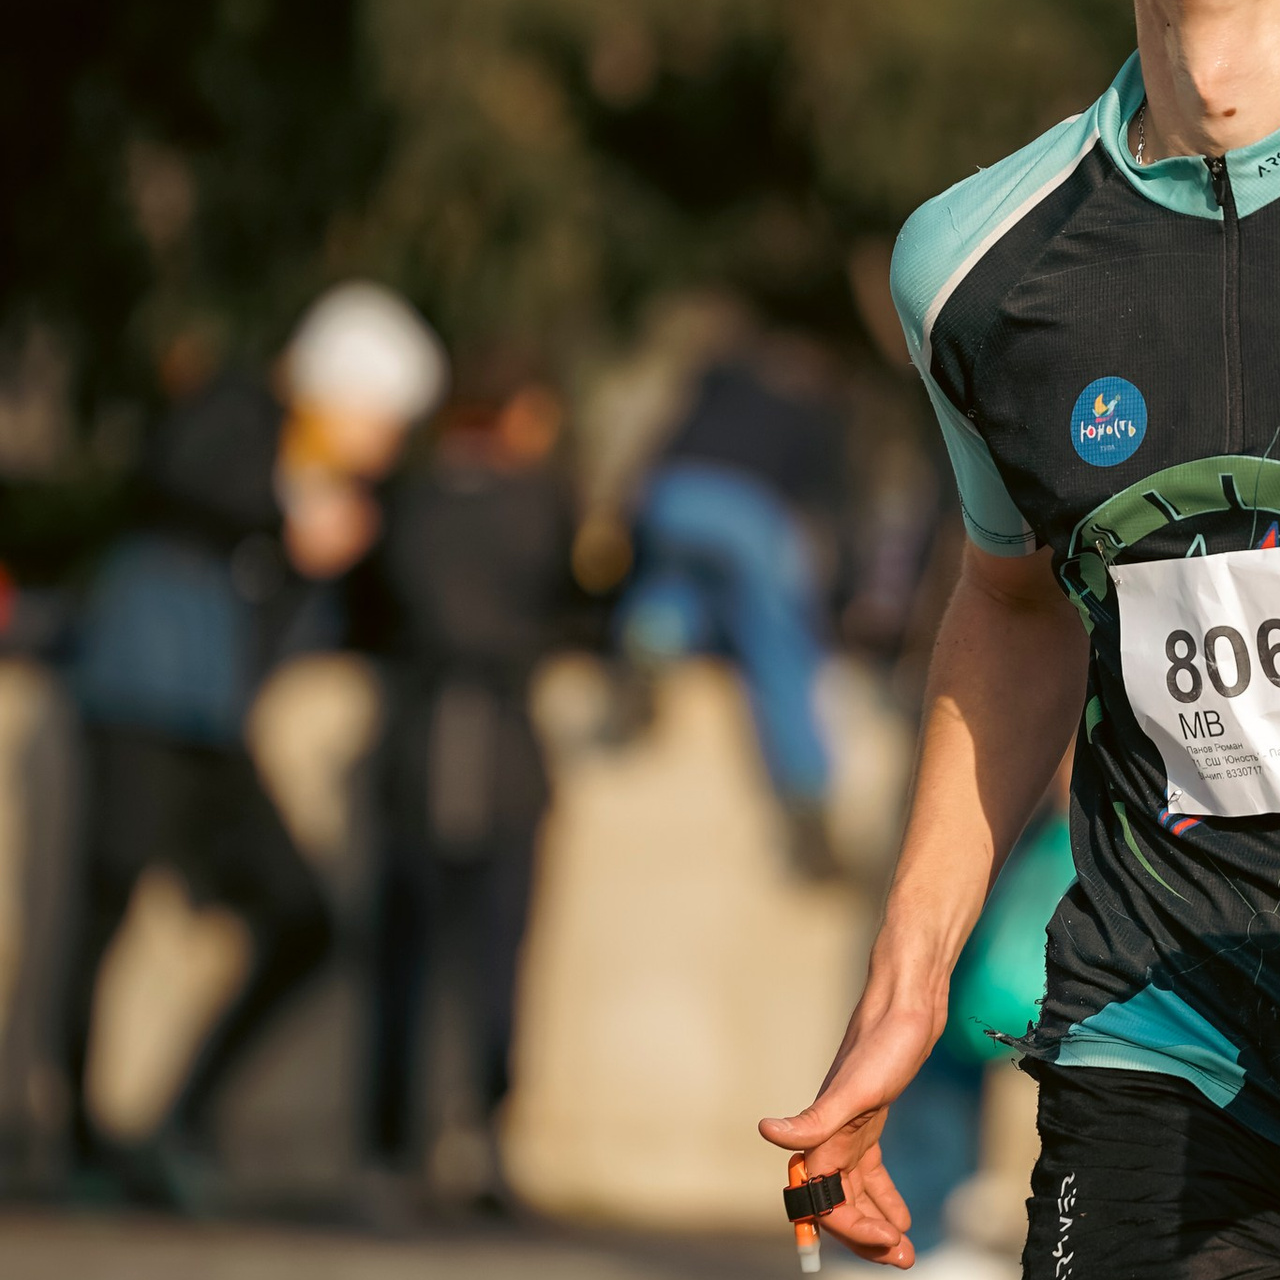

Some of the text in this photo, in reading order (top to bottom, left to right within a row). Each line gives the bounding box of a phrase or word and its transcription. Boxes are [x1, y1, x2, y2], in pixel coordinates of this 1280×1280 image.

[1186, 742, 1244, 755] Панов Роман
[1226, 765, 1263, 779] 8330717
